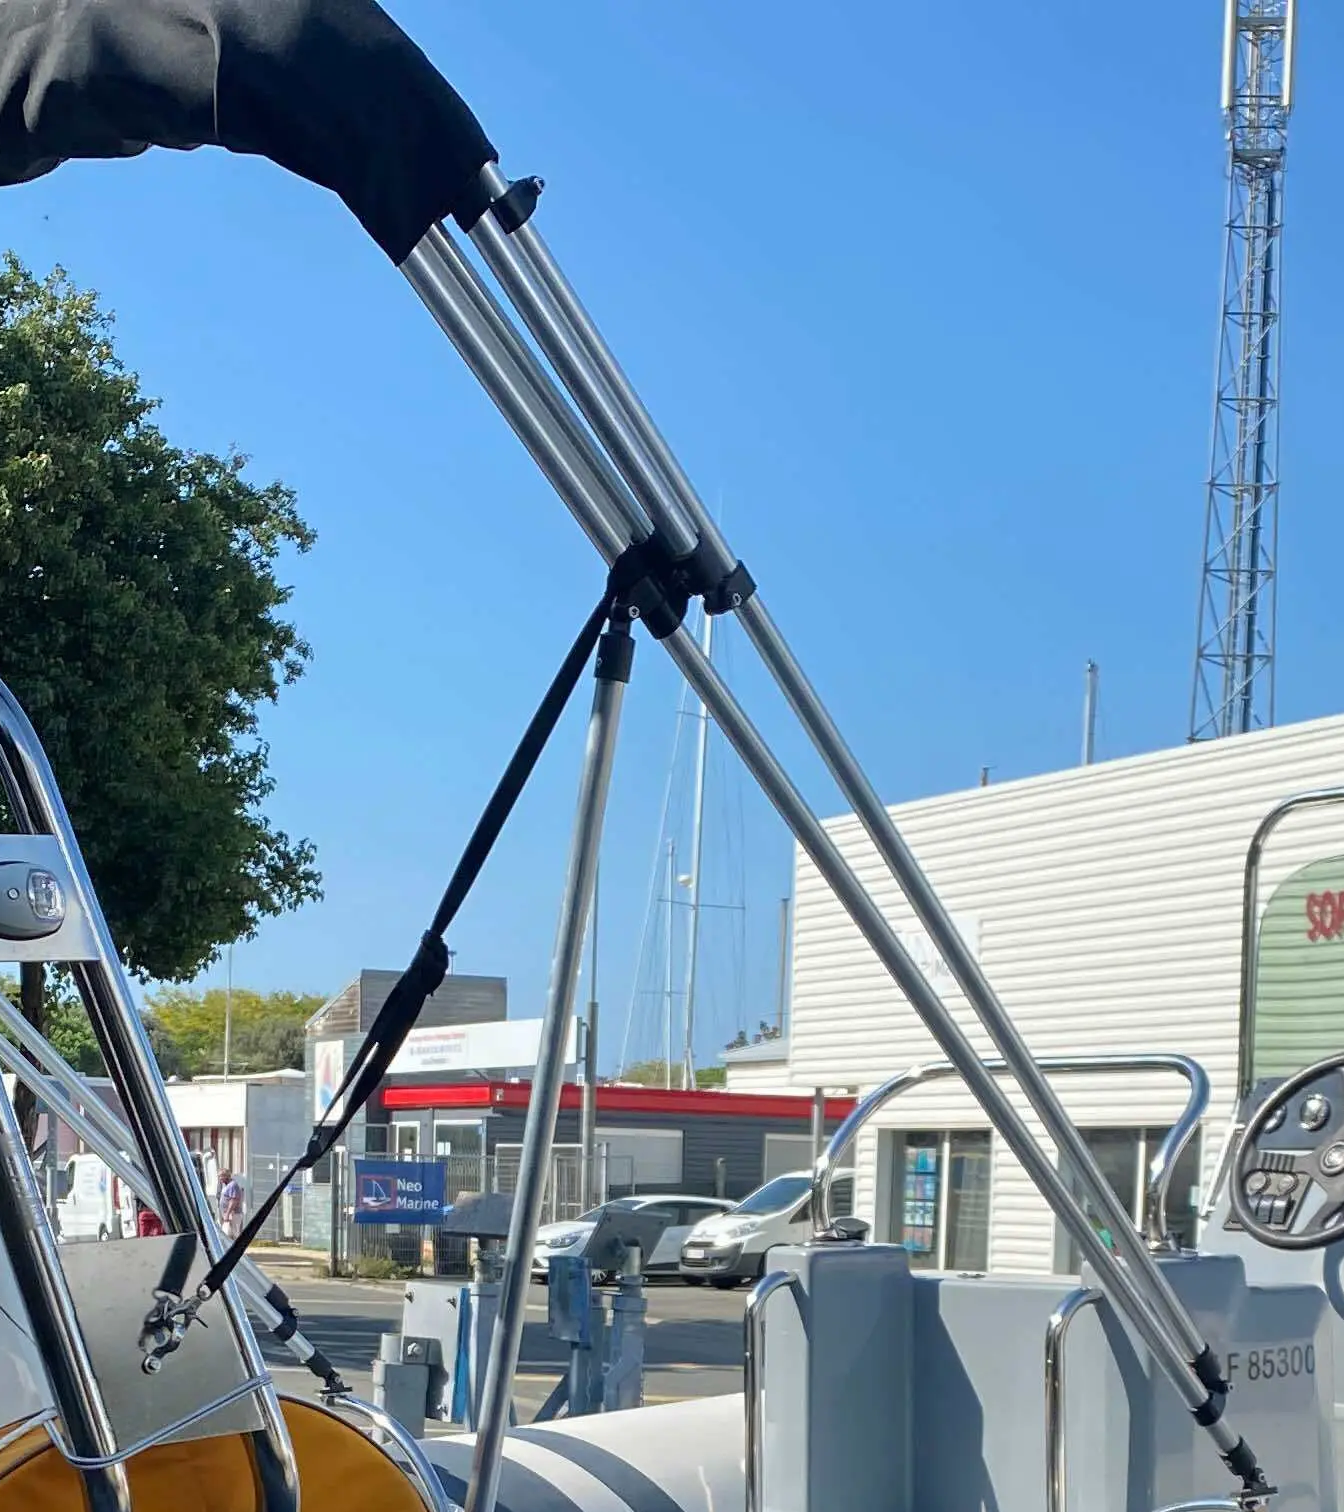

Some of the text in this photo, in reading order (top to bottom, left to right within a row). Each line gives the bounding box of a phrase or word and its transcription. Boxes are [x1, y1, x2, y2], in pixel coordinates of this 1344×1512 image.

[396, 1178, 423, 1193] Neo
[396, 1196, 440, 1210] Marine
[1247, 1345, 1315, 1381] 85300
